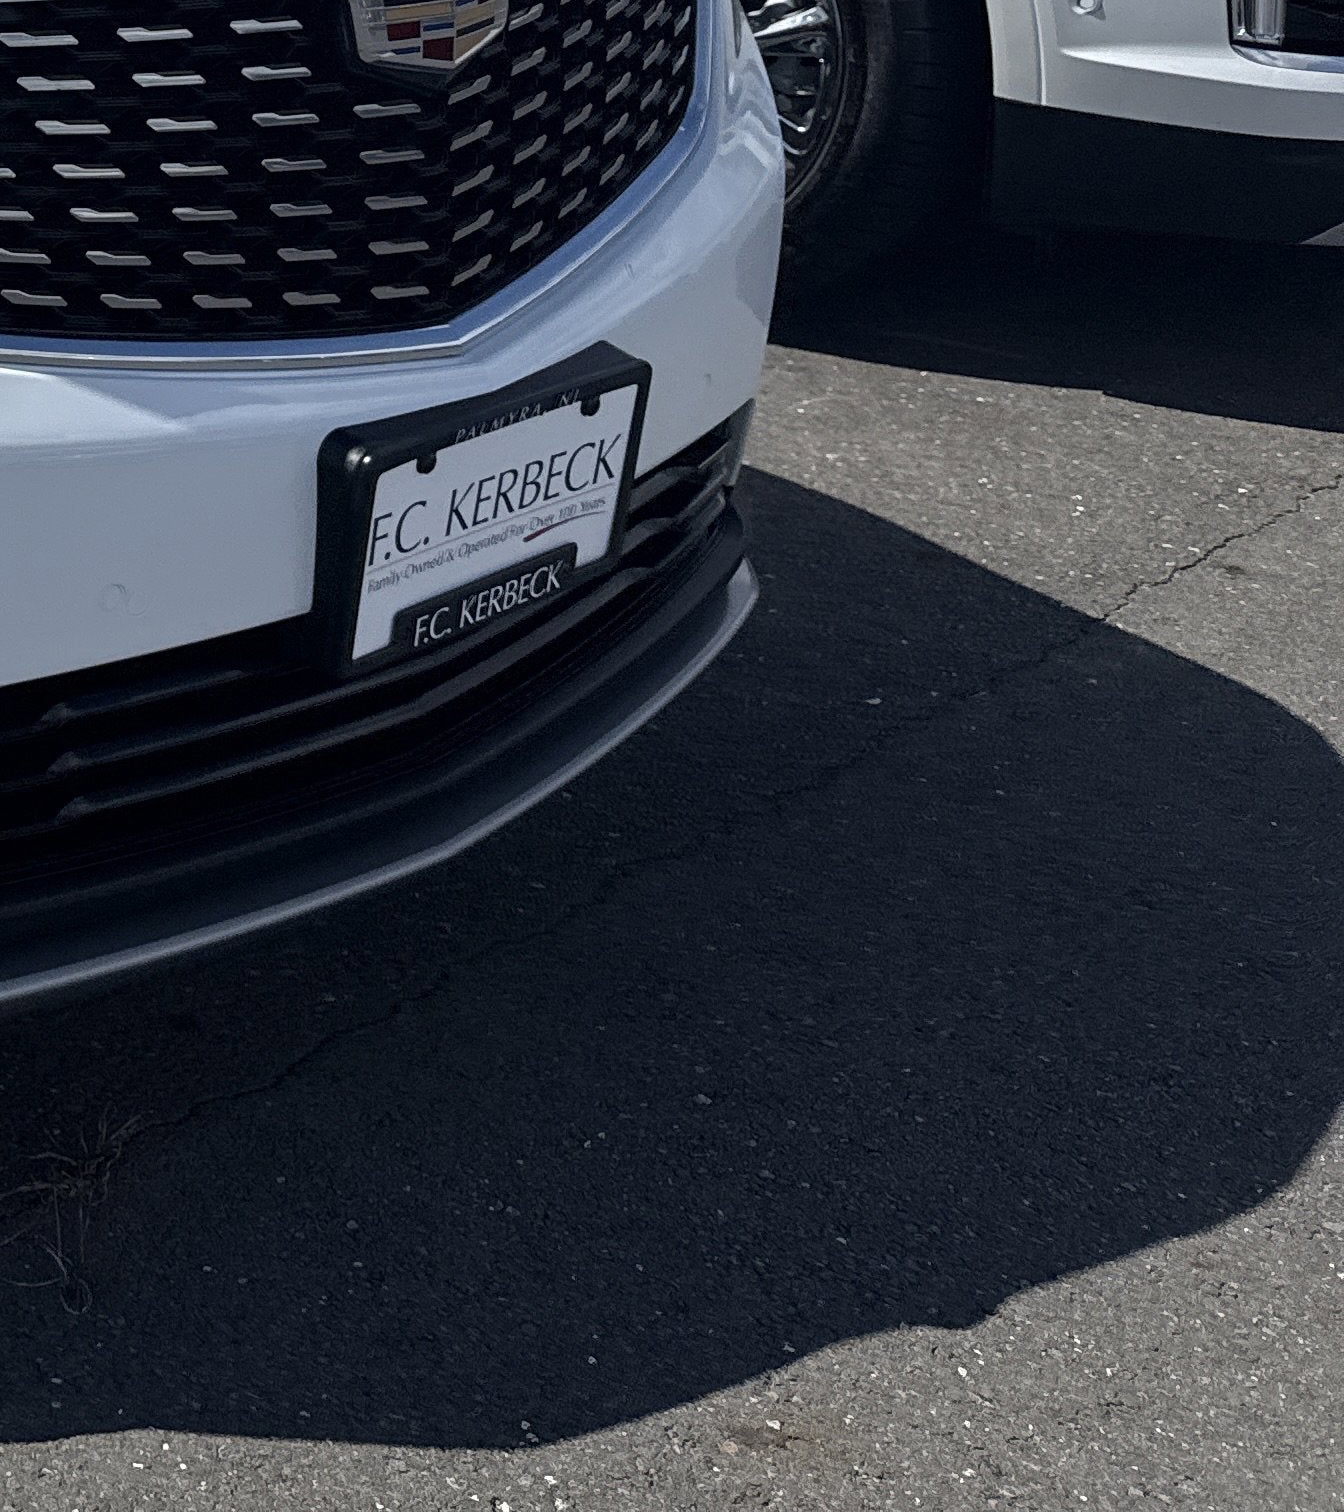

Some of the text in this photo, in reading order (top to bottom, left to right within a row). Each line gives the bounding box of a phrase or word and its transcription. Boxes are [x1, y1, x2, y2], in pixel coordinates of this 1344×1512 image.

[368, 433, 622, 567] F.C. KERBECK
[458, 533, 511, 558] Operated
[413, 560, 563, 647] F.C. KERBECK
